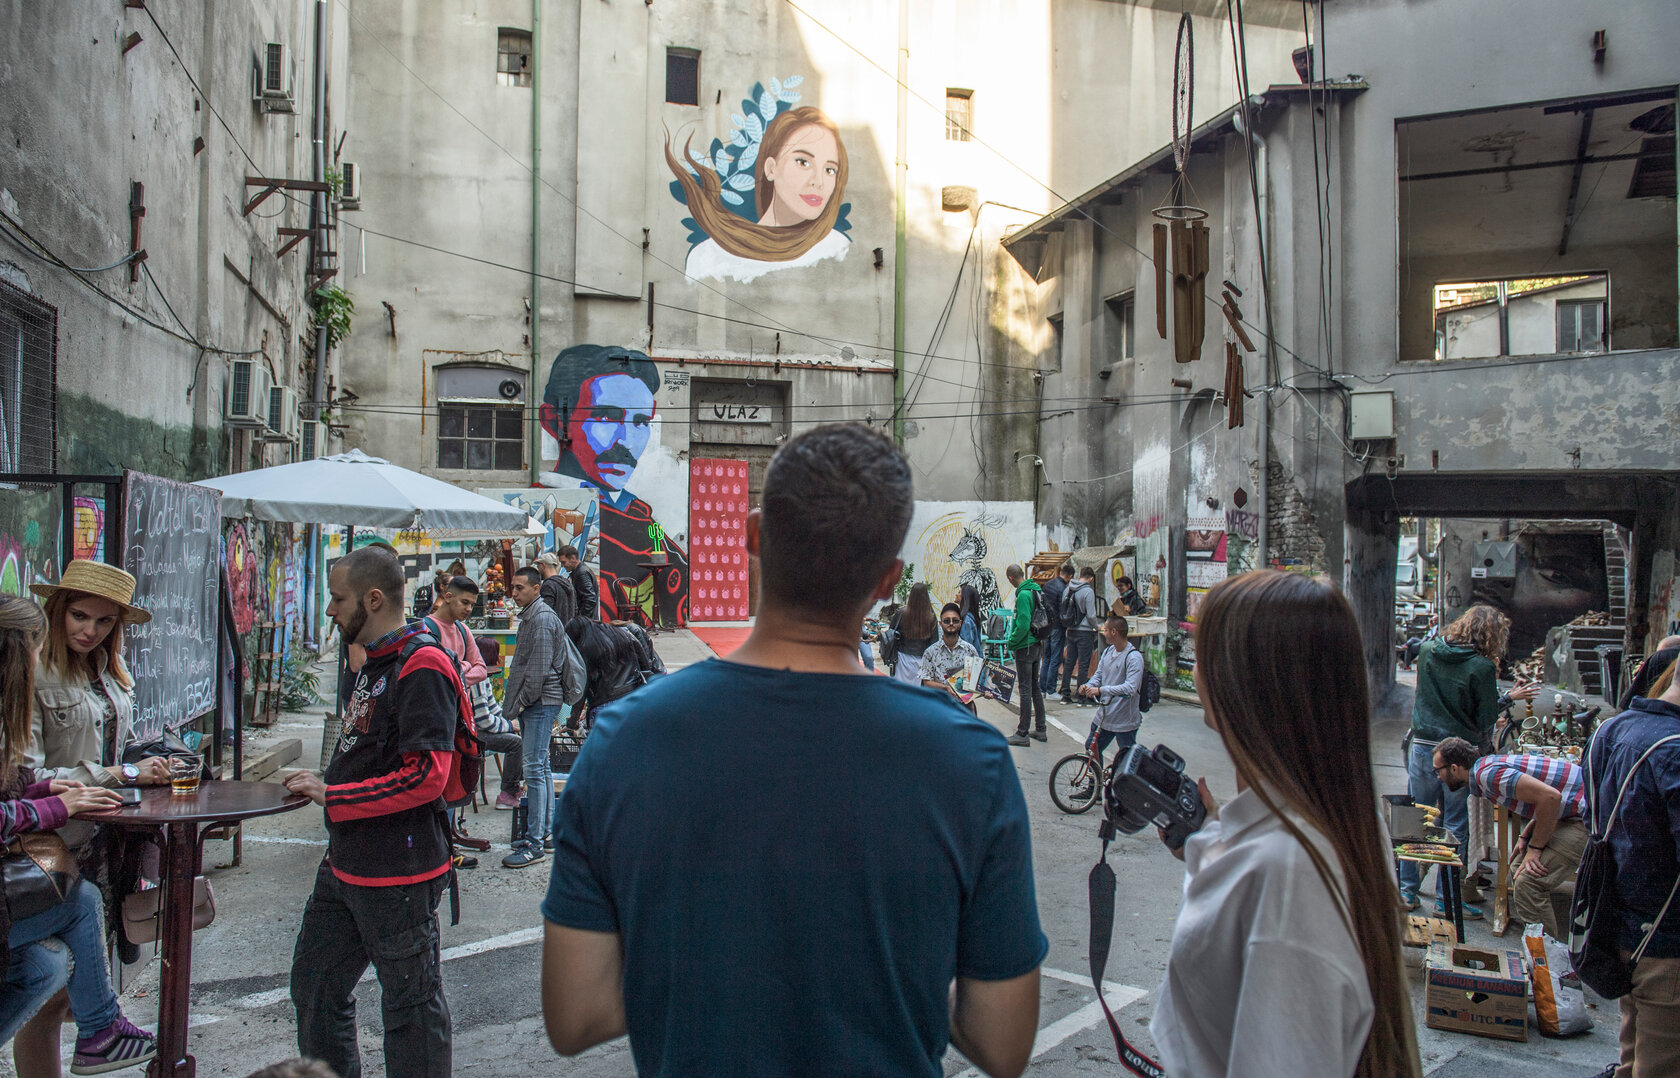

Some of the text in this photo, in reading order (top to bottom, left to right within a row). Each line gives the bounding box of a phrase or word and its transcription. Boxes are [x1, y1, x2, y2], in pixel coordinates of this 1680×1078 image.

[713, 404, 760, 419] ULAZ
[1431, 973, 1523, 994] PREMIUM BANANAS
